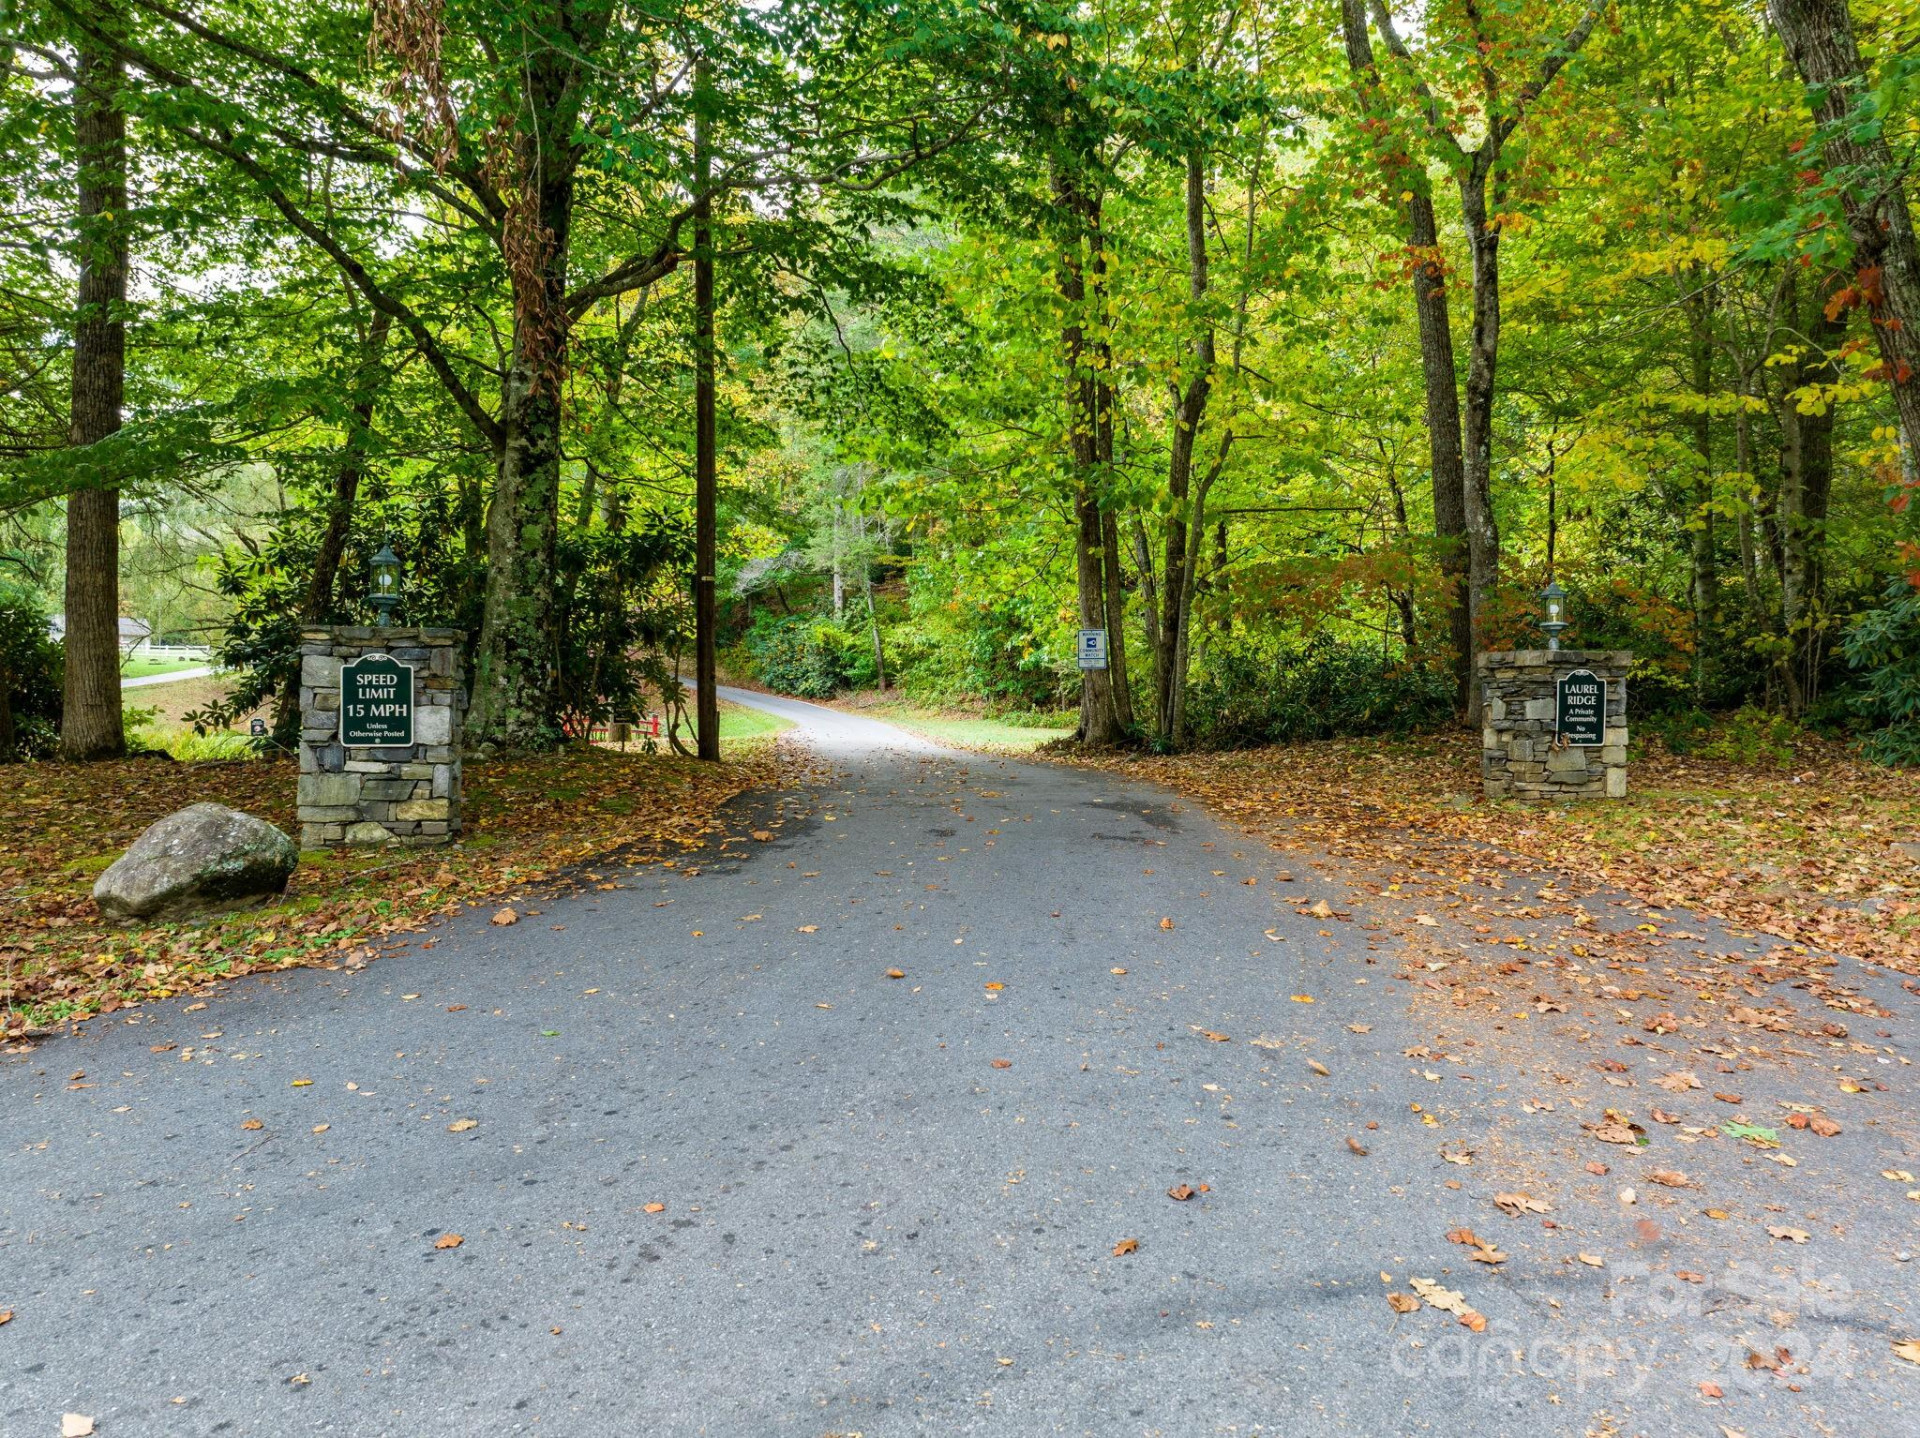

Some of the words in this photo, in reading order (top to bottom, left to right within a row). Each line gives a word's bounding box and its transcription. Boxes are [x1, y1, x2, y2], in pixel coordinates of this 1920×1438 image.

[356, 674, 397, 685] SPEED
[358, 688, 396, 699] LIMIT
[1565, 684, 1599, 694] LAUREL
[1567, 695, 1597, 705] RIDGE
[347, 704, 365, 717] 15
[370, 704, 407, 717] MPH
[1565, 715, 1597, 723] Community
